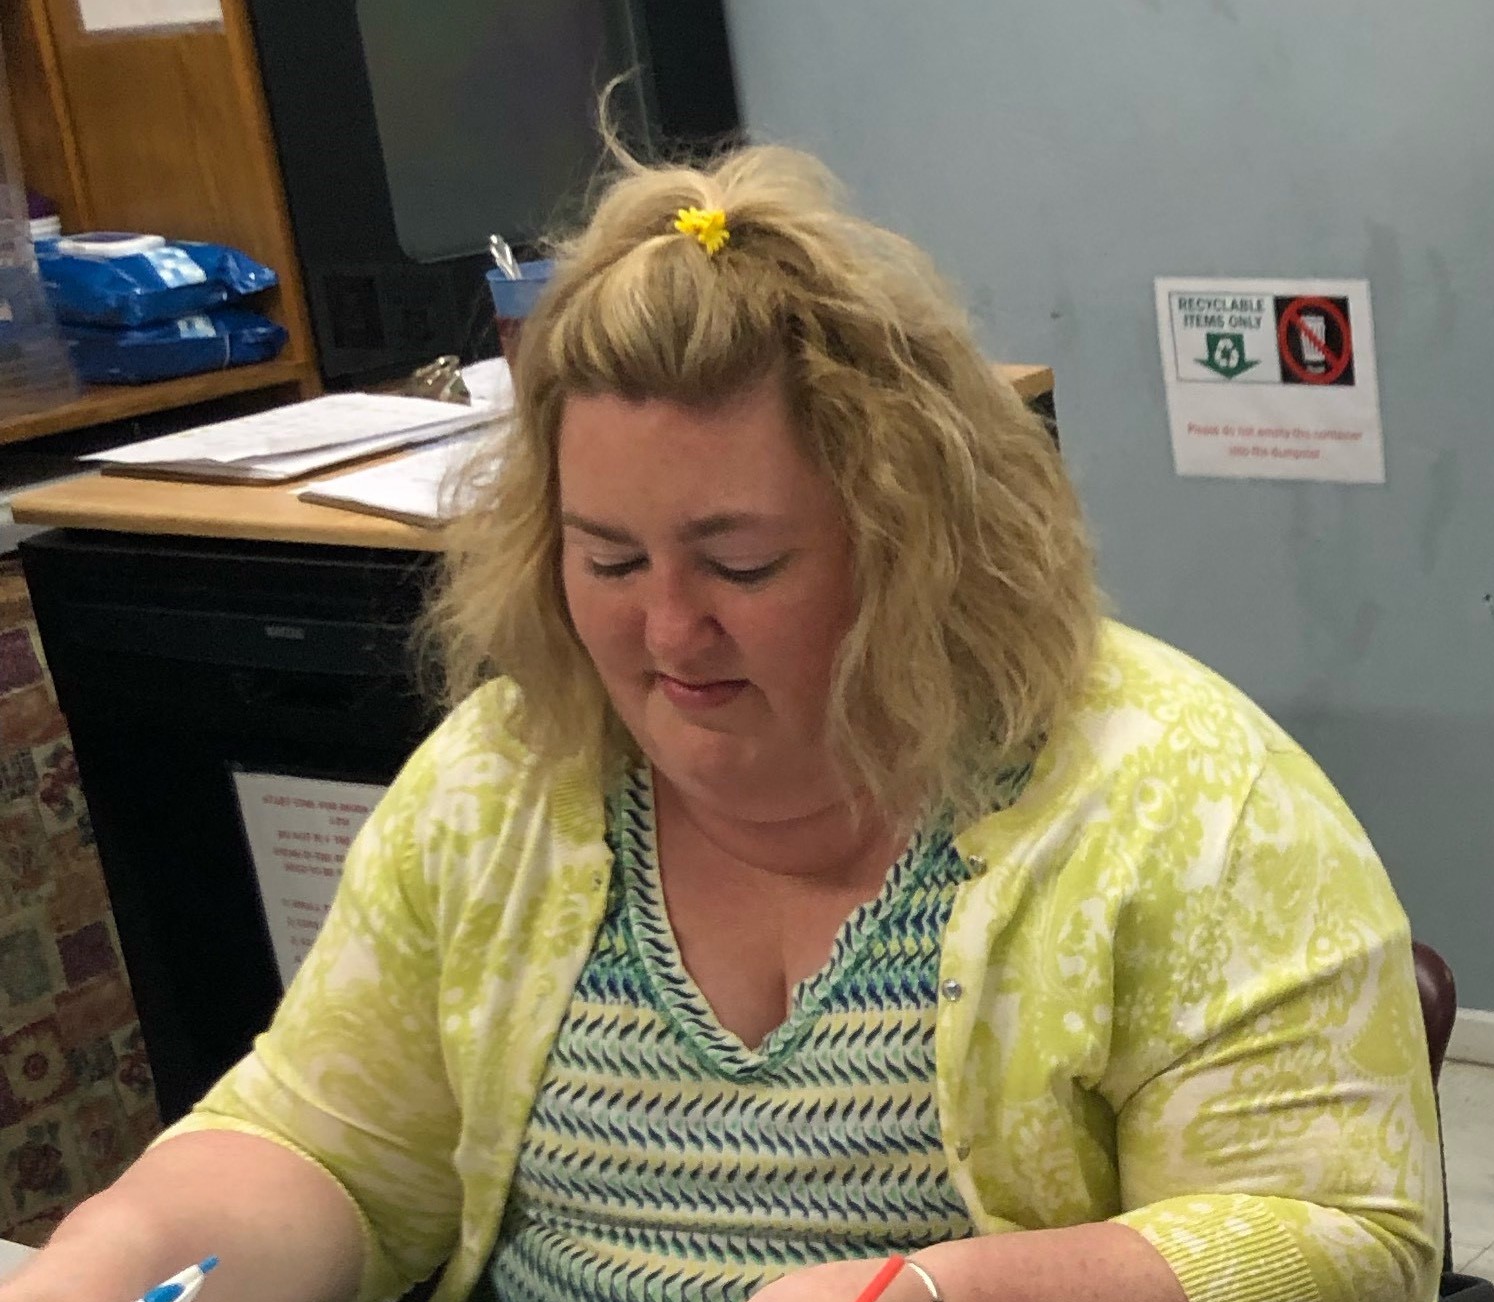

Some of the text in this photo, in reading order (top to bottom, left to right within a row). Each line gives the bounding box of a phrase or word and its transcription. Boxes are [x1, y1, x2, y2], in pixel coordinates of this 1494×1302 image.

[1178, 297, 1265, 311] RECYCLABLE
[1183, 315, 1262, 329] ITEMS ONLY
